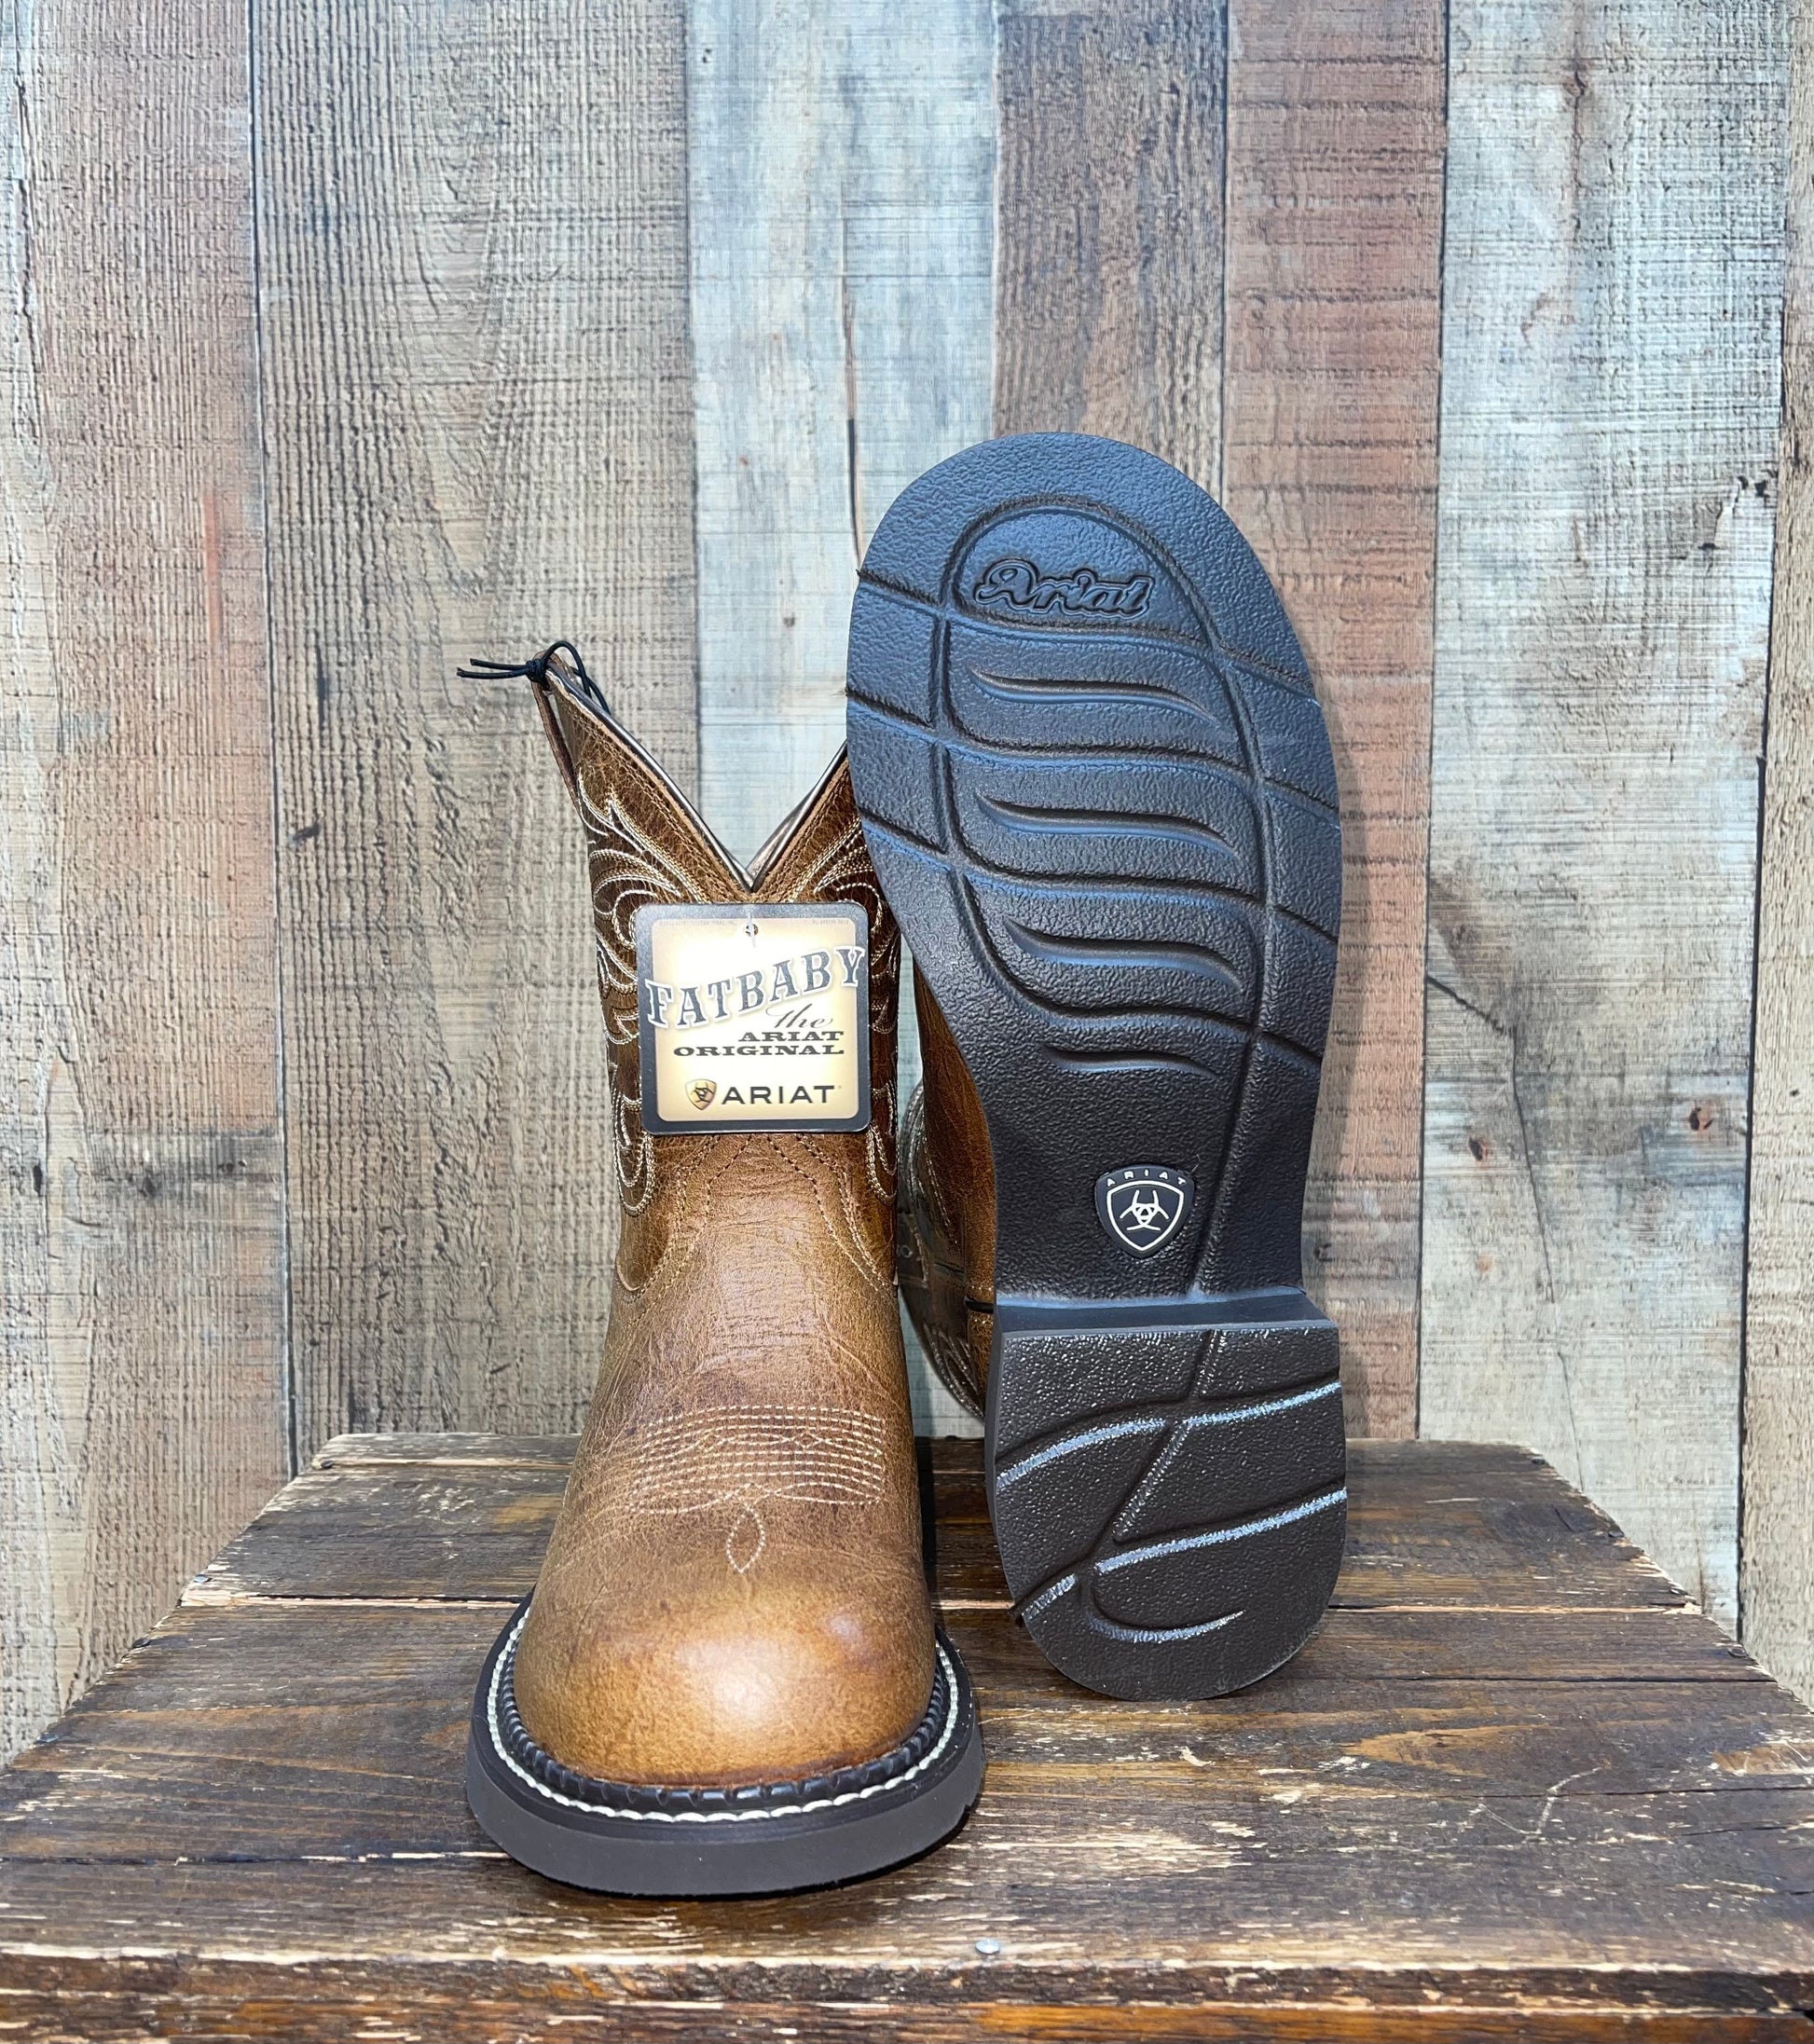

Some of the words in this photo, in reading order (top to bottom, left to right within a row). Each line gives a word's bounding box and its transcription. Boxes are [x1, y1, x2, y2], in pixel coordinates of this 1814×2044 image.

[974, 558, 1155, 619] Ariat
[646, 946, 864, 1028] FATBABY
[738, 1031, 845, 1042] ARIAT
[673, 1045, 845, 1057] ORIGINAL
[721, 1085, 835, 1104] ARIAT
[1106, 1169, 1187, 1187] ARIAT
